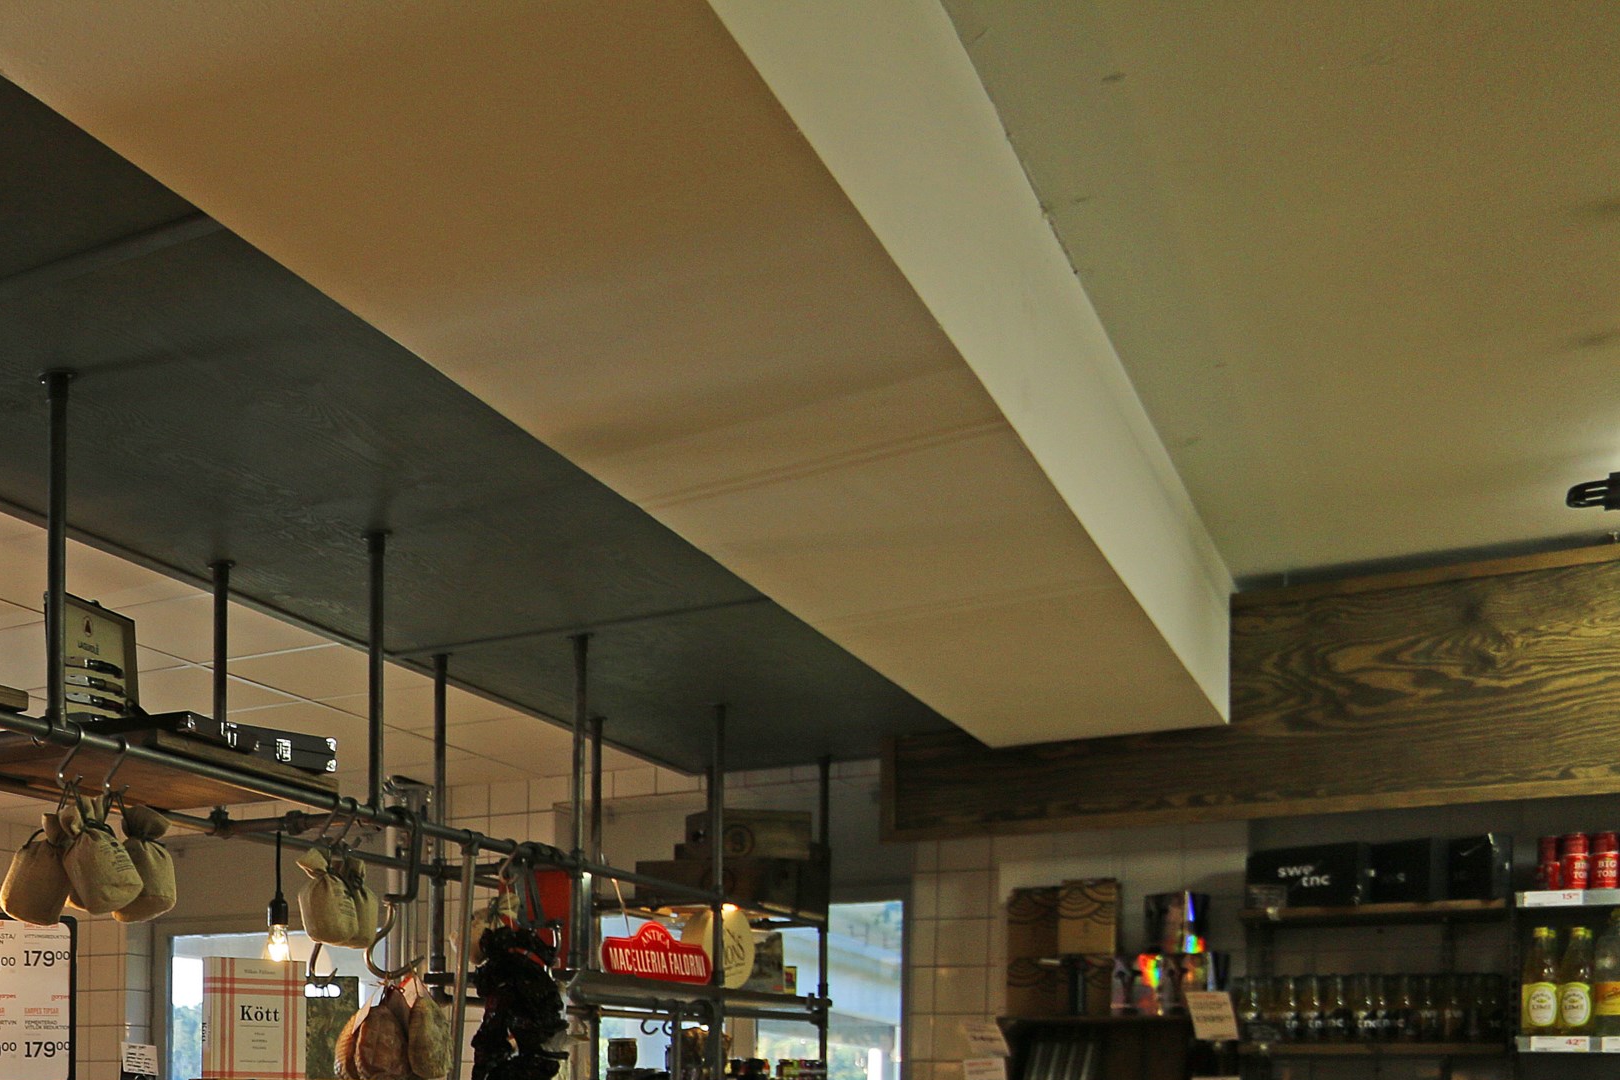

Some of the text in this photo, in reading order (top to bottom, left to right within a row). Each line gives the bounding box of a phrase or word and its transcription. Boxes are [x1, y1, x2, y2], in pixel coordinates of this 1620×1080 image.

[1598, 860, 1617, 870] BIG
[1597, 869, 1618, 879] TOM
[640, 930, 670, 949] ANTICA
[609, 947, 706, 977] MACELLERIA FALORNI
[240, 1005, 280, 1022] Kött
